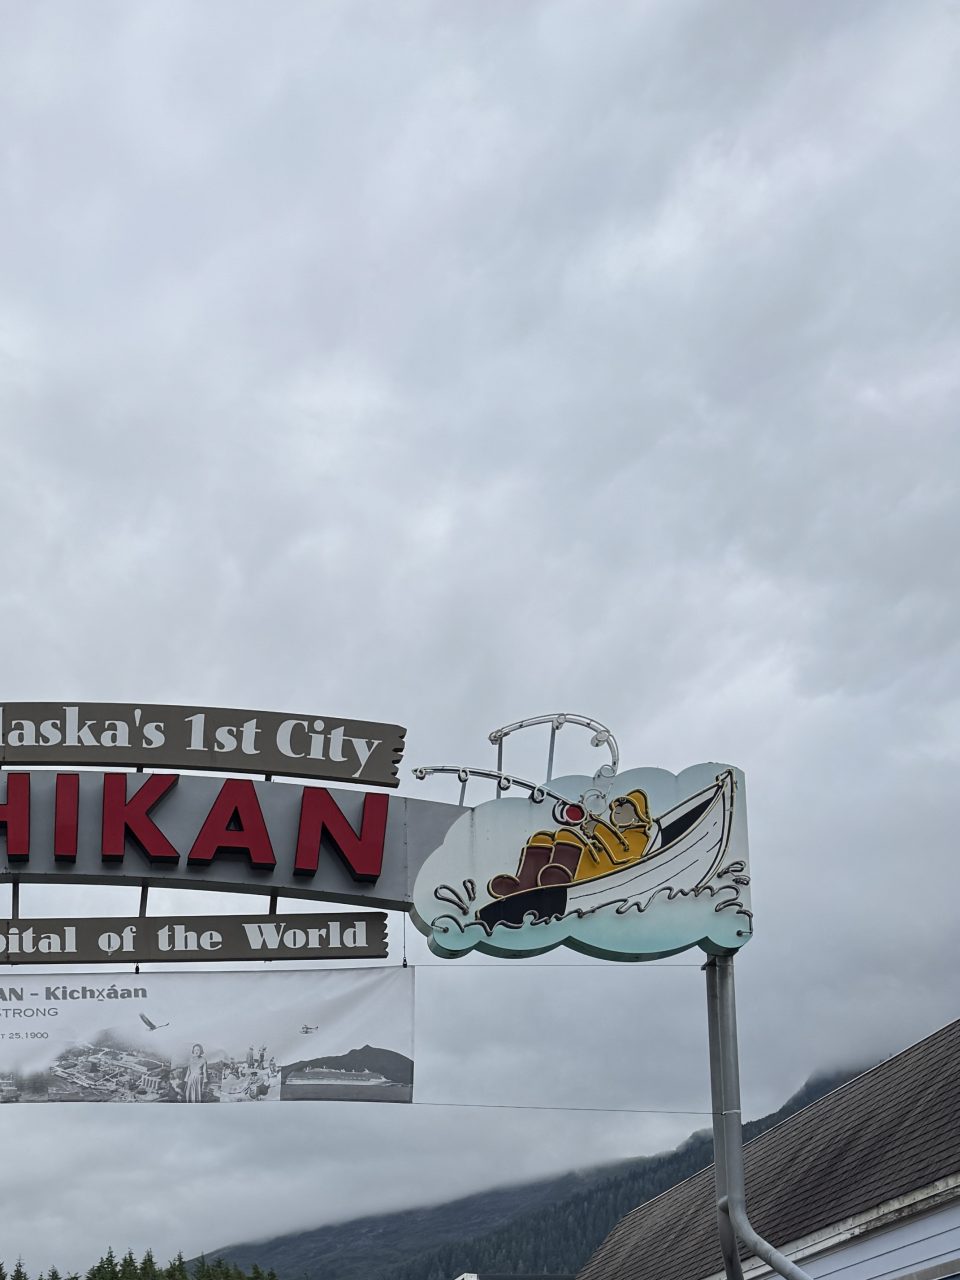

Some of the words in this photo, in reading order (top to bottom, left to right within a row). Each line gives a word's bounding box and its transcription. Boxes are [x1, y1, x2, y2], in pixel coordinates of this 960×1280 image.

[184, 713, 262, 755] 1st
[276, 718, 382, 778] City
[97, 925, 138, 955] of
[157, 924, 223, 952] the
[241, 921, 369, 950] World
